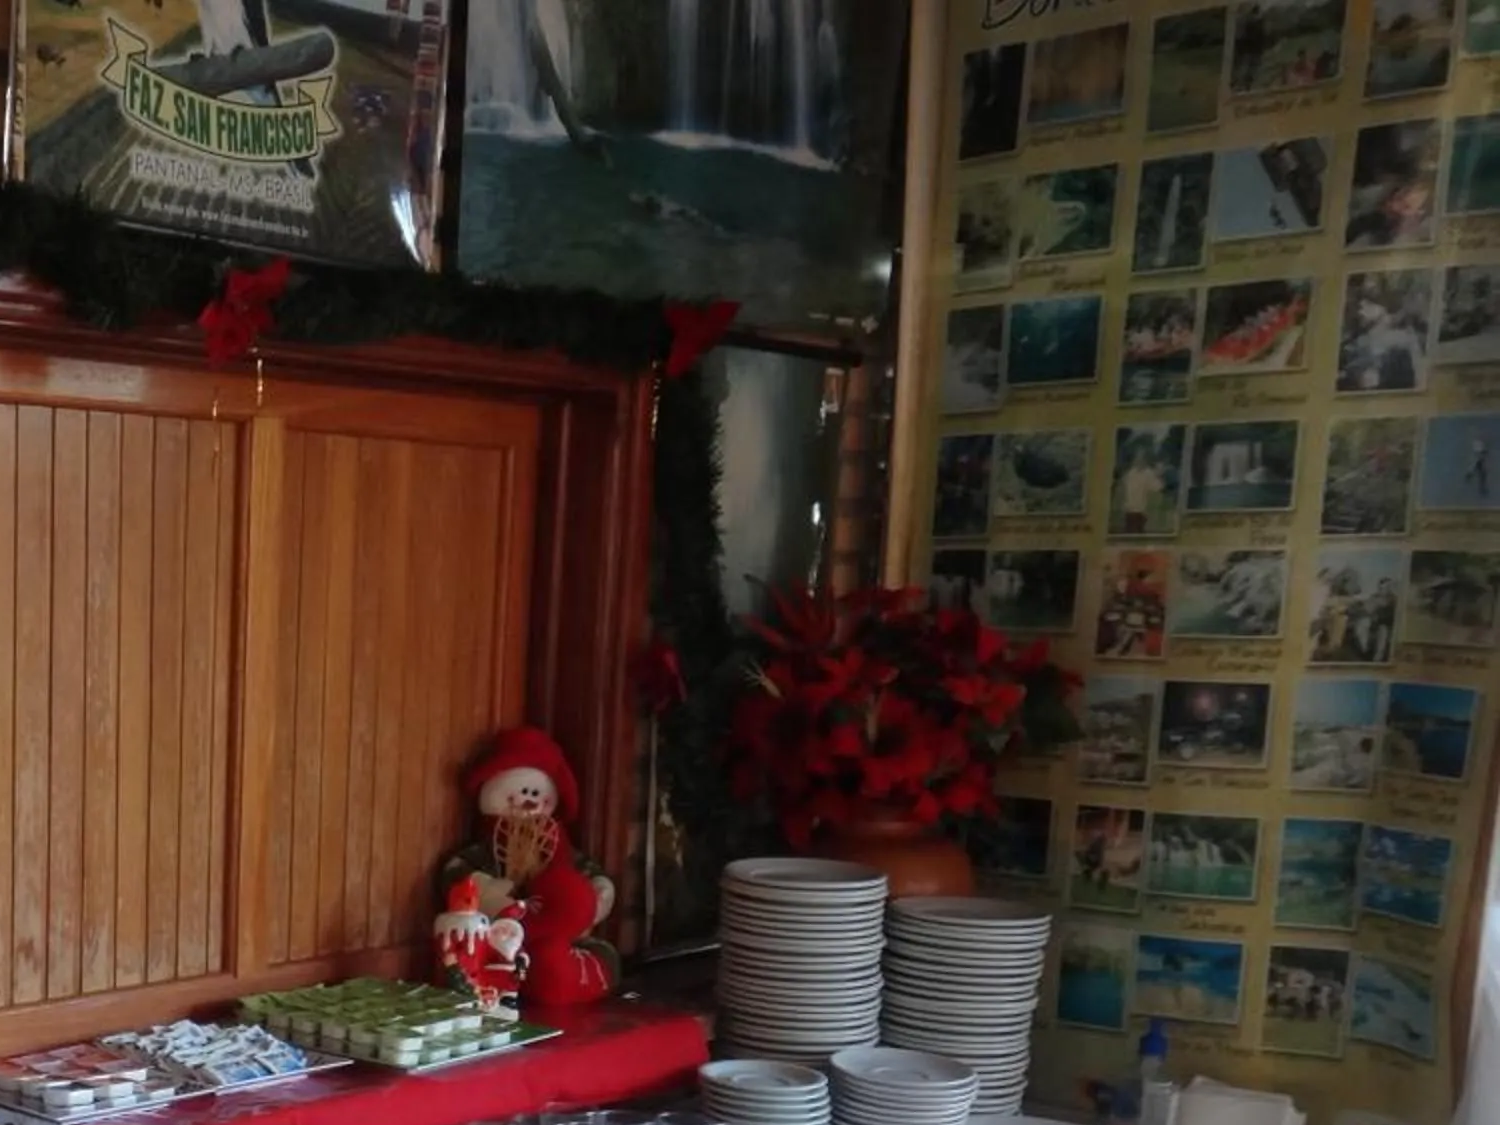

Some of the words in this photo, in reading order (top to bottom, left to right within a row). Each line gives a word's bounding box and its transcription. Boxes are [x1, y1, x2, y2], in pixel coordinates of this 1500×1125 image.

[129, 68, 171, 130] FAZ.
[173, 91, 211, 145] SAN
[216, 104, 313, 155] FRANCISCO
